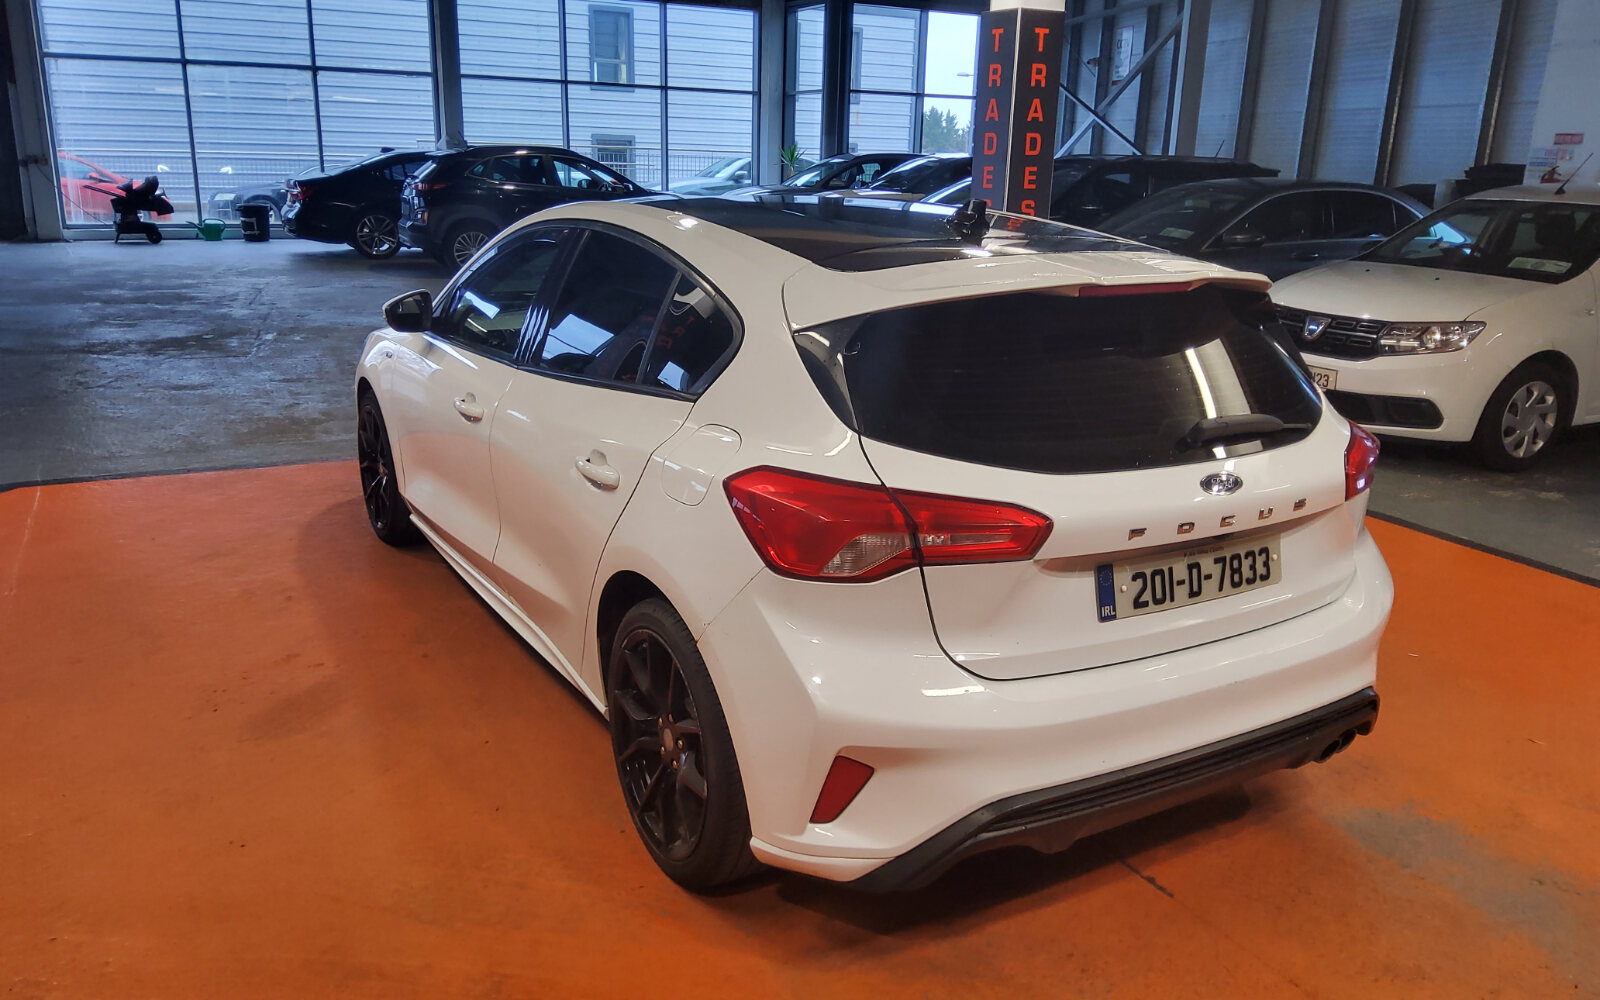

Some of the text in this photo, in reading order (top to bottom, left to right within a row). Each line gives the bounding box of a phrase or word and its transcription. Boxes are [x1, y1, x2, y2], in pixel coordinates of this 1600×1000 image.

[982, 27, 1005, 208] TRADE
[1128, 498, 1307, 541] FOCUS
[1131, 546, 1271, 610] 201-D-7833
[1101, 606, 1116, 618] IRL
